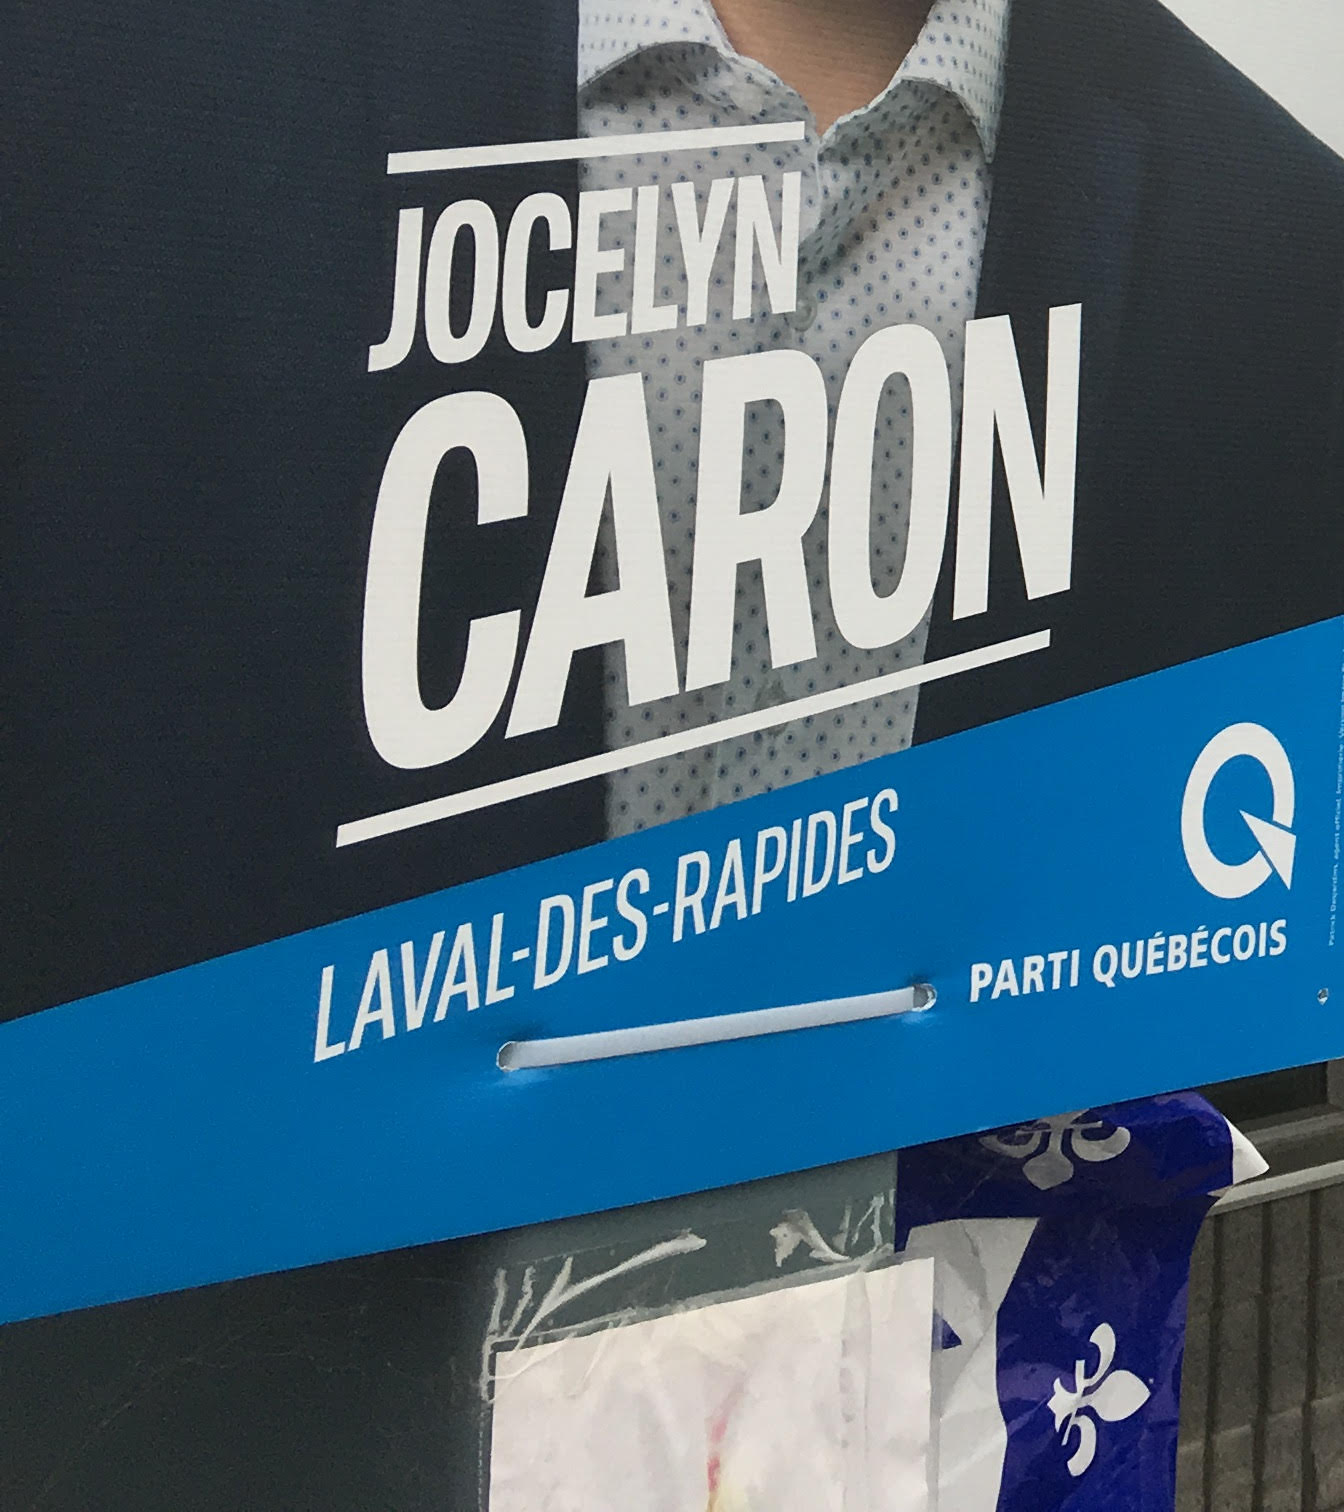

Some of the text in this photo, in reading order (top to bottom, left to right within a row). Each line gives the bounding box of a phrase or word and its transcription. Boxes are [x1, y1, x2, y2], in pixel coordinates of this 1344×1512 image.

[368, 170, 801, 372] JOCELYN
[361, 302, 1083, 771] CARON
[312, 788, 900, 1063] LAVAL-DES-RAPIDES
[968, 916, 1289, 1003] PARTI QUÉBÉCOIS
